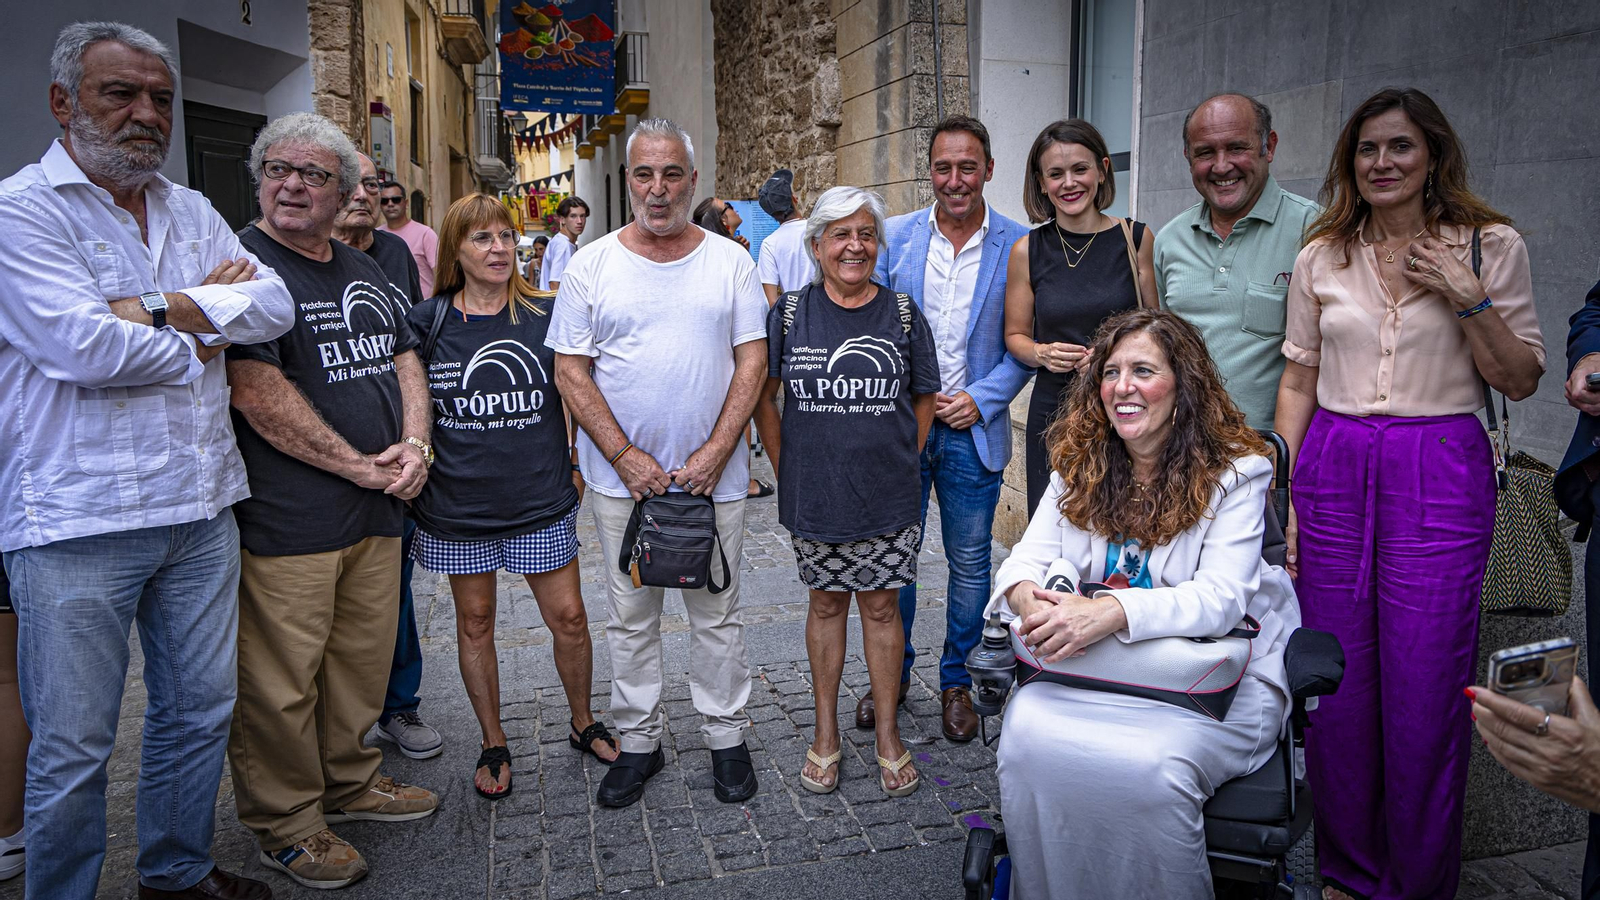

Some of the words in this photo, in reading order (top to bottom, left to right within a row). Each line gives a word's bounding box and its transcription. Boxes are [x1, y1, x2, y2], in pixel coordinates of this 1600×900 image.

[241, 1, 251, 25] 2
[305, 313, 317, 322] de
[896, 293, 911, 333] BIMBA
[312, 325, 318, 334] y
[317, 341, 350, 368] EL
[327, 368, 349, 384] Mi
[350, 364, 382, 379] barrio,
[433, 371, 461, 379] vecinos
[789, 364, 795, 372] y
[794, 363, 822, 371] amigos
[433, 381, 457, 390] amigos
[789, 379, 812, 399] EL
[816, 374, 901, 400] PÓPULO
[453, 389, 544, 417] PÓPULO
[797, 401, 809, 412] Mi
[810, 402, 846, 415] barrio,
[848, 402, 864, 413] mi
[437, 416, 455, 428] Mi
[455, 419, 487, 431] barrio,
[488, 417, 504, 429] mi
[507, 412, 542, 430] orgullo
